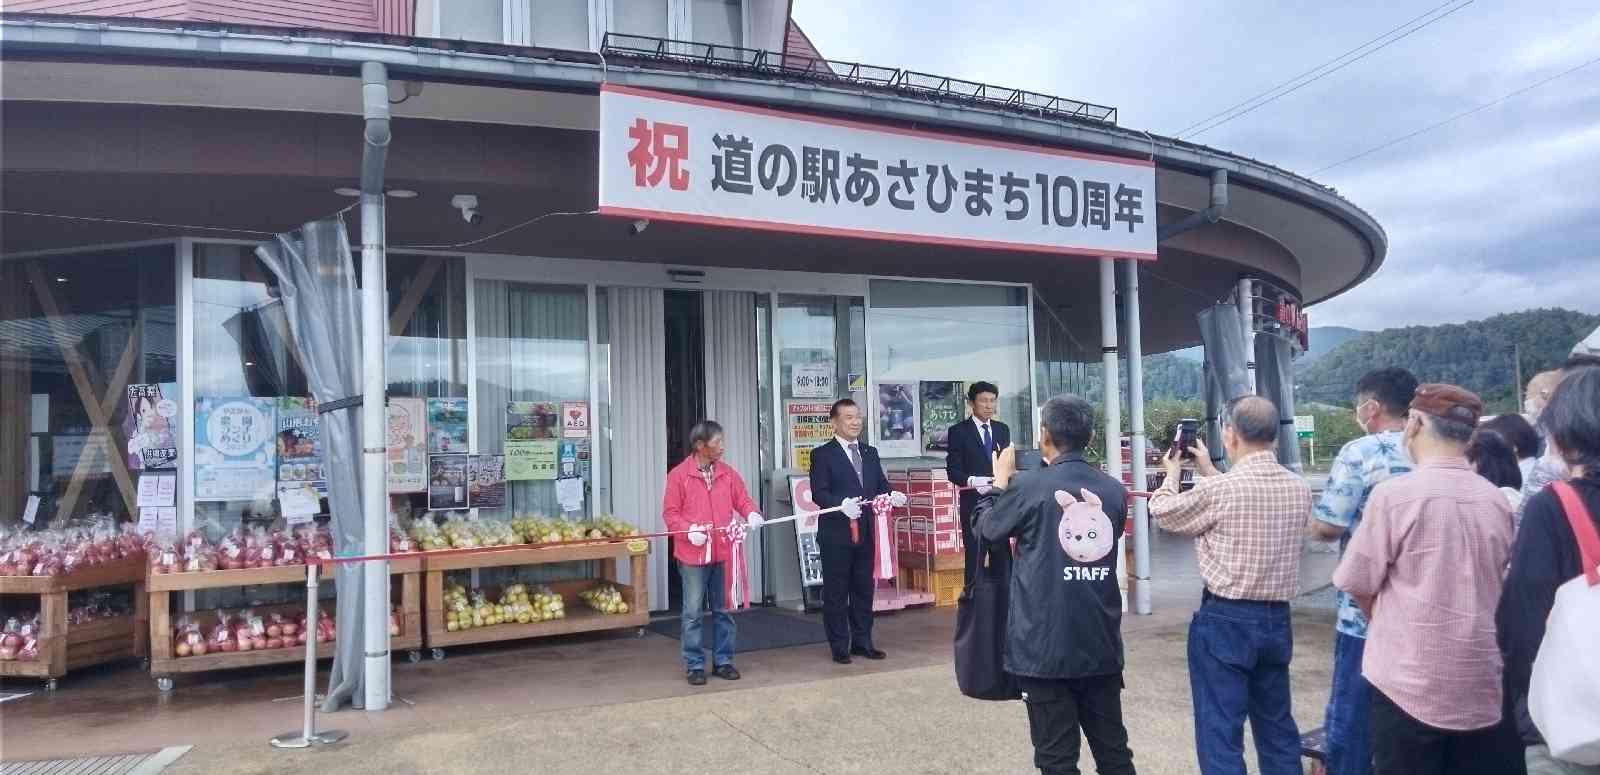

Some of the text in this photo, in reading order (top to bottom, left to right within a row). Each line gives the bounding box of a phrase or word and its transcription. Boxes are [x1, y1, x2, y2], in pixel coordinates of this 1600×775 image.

[628, 117, 1144, 233] 祝 道の駅あさひまち10周年
[1064, 566, 1110, 581] STAFF
